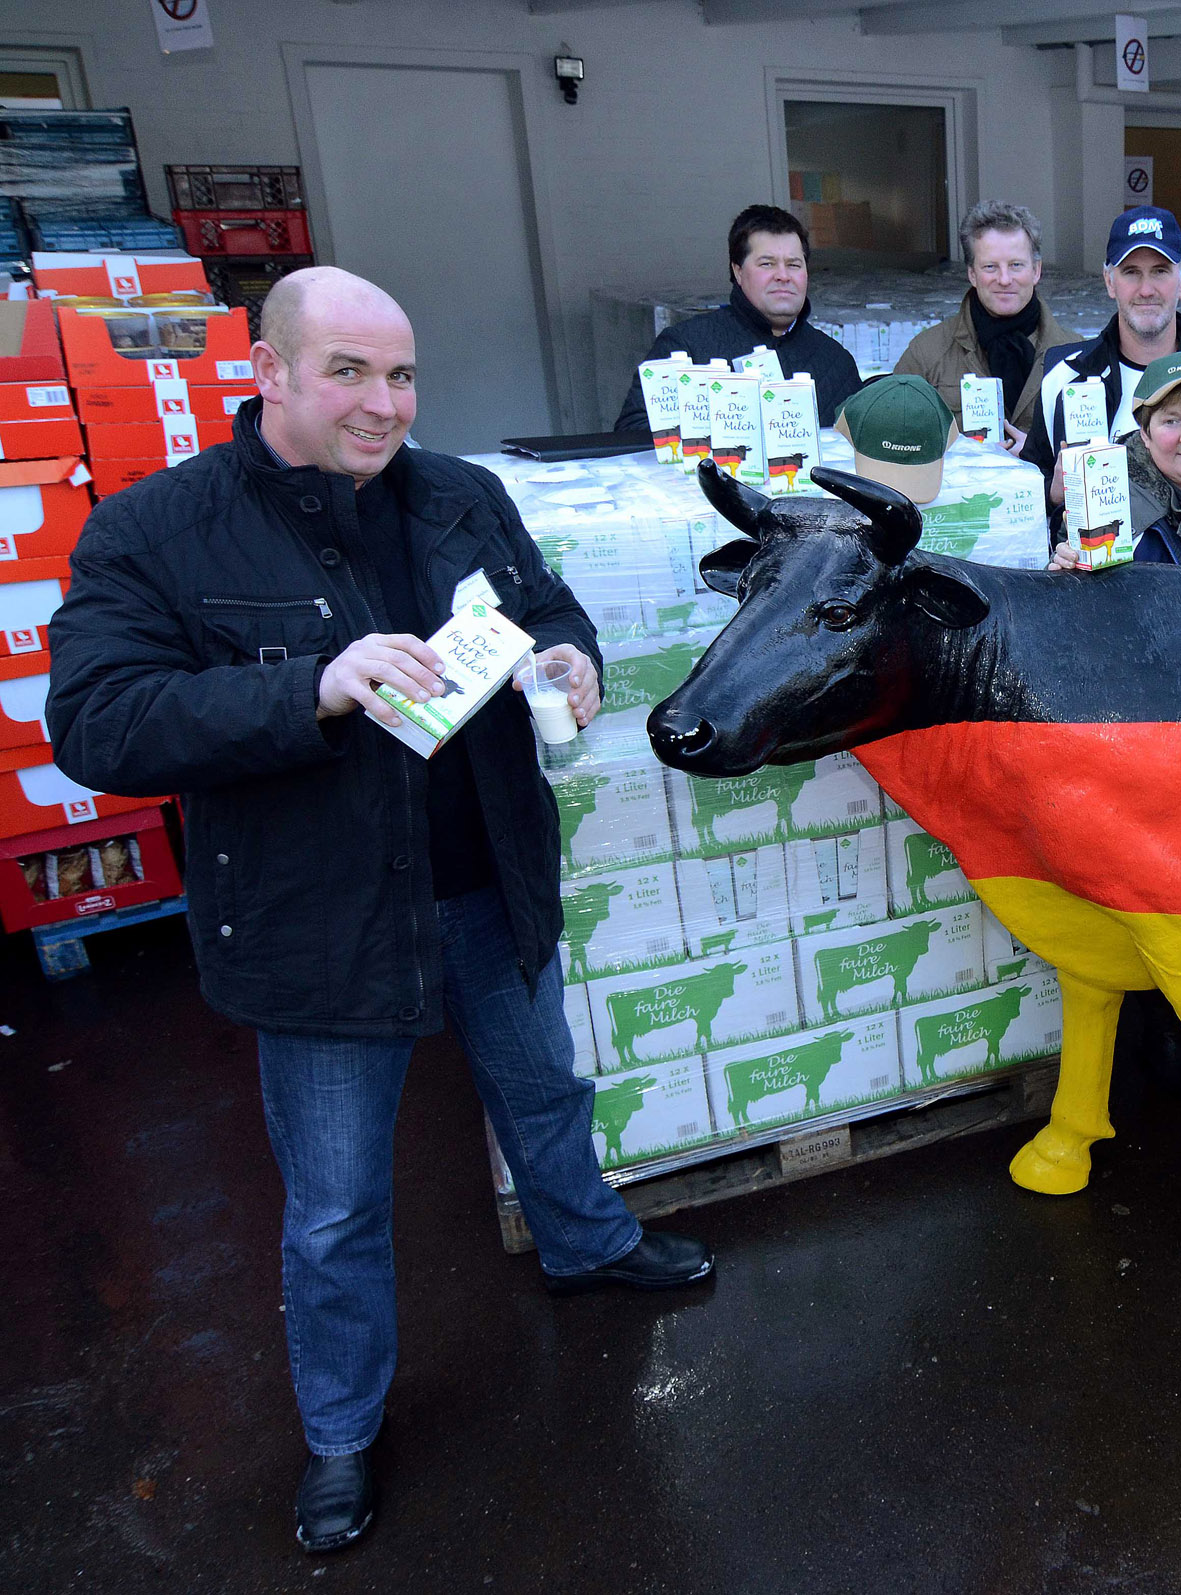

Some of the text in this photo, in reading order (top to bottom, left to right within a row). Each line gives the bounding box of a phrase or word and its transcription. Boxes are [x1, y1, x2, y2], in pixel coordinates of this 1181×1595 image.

[1129, 219, 1163, 236] BDM
[697, 394, 709, 402] Di
[684, 401, 710, 412] fair
[728, 402, 749, 412] Die
[693, 412, 710, 421] Mil
[715, 410, 744, 421] faire
[782, 410, 803, 420] Die
[724, 420, 757, 431] Milch
[768, 418, 799, 430] faire
[778, 428, 813, 439] Milch
[891, 444, 922, 452] KRONE
[1101, 475, 1120, 486] Die
[1091, 485, 1116, 499] faire
[1100, 492, 1127, 507] Milch
[1013, 504, 1034, 513] Liter
[447, 630, 487, 660] faire
[473, 634, 499, 656] Die
[448, 645, 491, 680] Milch
[606, 664, 639, 679] Die
[602, 688, 656, 707] Milch
[623, 783, 648, 793] Liter
[716, 776, 763, 795] faire
[731, 784, 782, 804] Milch
[638, 878, 650, 886] 12
[636, 888, 660, 899] Liter
[953, 914, 963, 922] 12
[951, 924, 971, 934] Liter
[857, 943, 887, 956] Die
[760, 955, 771, 963] 12
[839, 955, 881, 972] faire
[759, 965, 781, 977] Liter
[853, 964, 899, 981] Milch
[653, 985, 686, 1000] Die
[1041, 988, 1058, 998] Liter
[634, 998, 682, 1017] faire
[650, 1005, 700, 1025] Milch
[954, 1009, 982, 1023] Die
[938, 1020, 977, 1038] faire
[864, 1032, 885, 1044] Liter
[950, 1026, 991, 1046] Milch
[768, 1053, 798, 1068] Die
[749, 1066, 792, 1083] faire
[668, 1079, 690, 1089] Liter
[764, 1073, 810, 1092] Milch
[822, 1138, 840, 1150] 993
